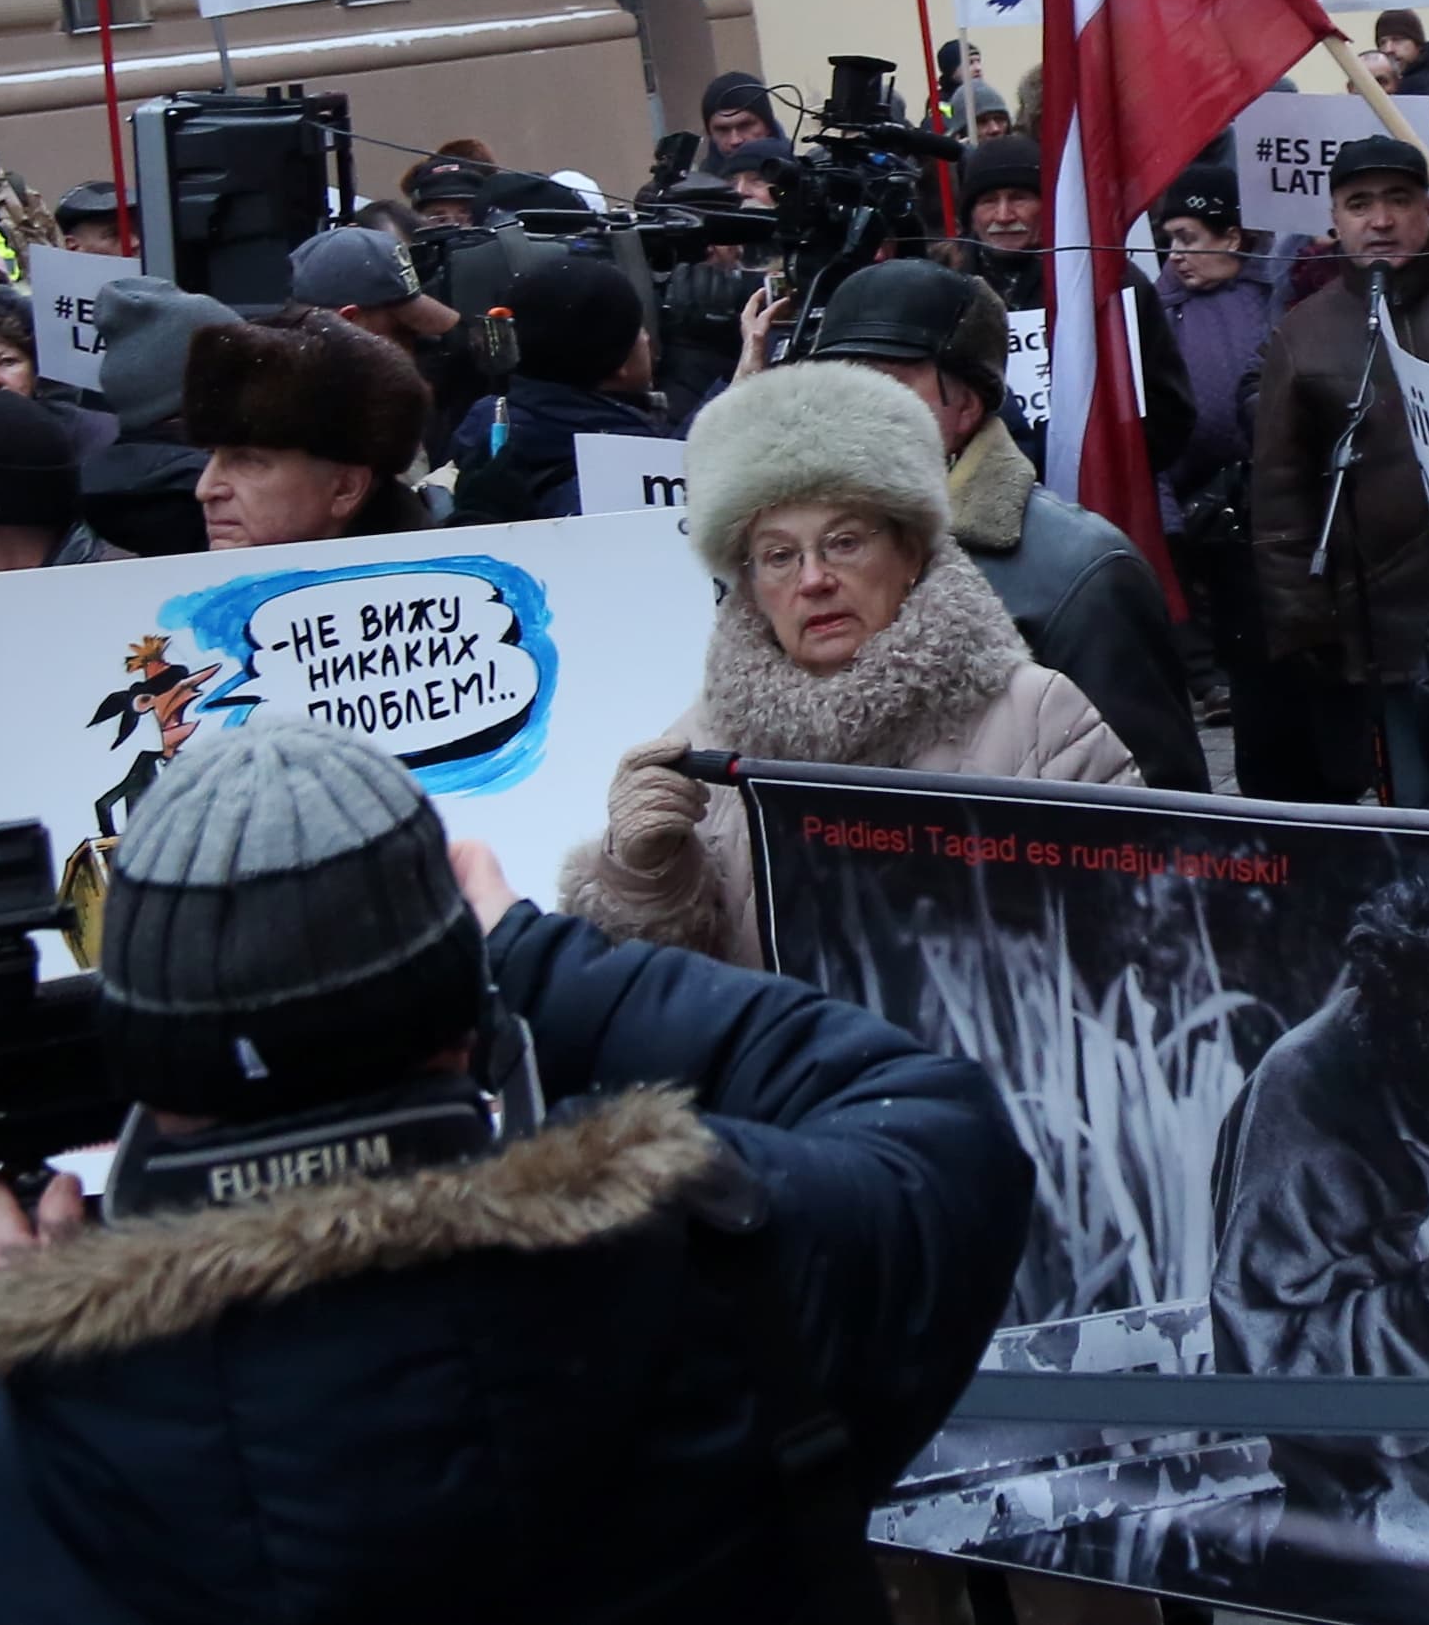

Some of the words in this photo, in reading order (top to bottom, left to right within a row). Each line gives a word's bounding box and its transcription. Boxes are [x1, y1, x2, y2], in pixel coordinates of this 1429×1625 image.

[1256, 136, 1311, 166] #ES
[360, 596, 461, 642] ВИЖУ
[308, 633, 480, 692] НИКАКИХ
[802, 816, 915, 854] Paldies!
[927, 826, 1018, 867] Tagad
[1026, 839, 1063, 867] es
[1071, 840, 1167, 881] runāju
[1174, 850, 1290, 887] latviski!
